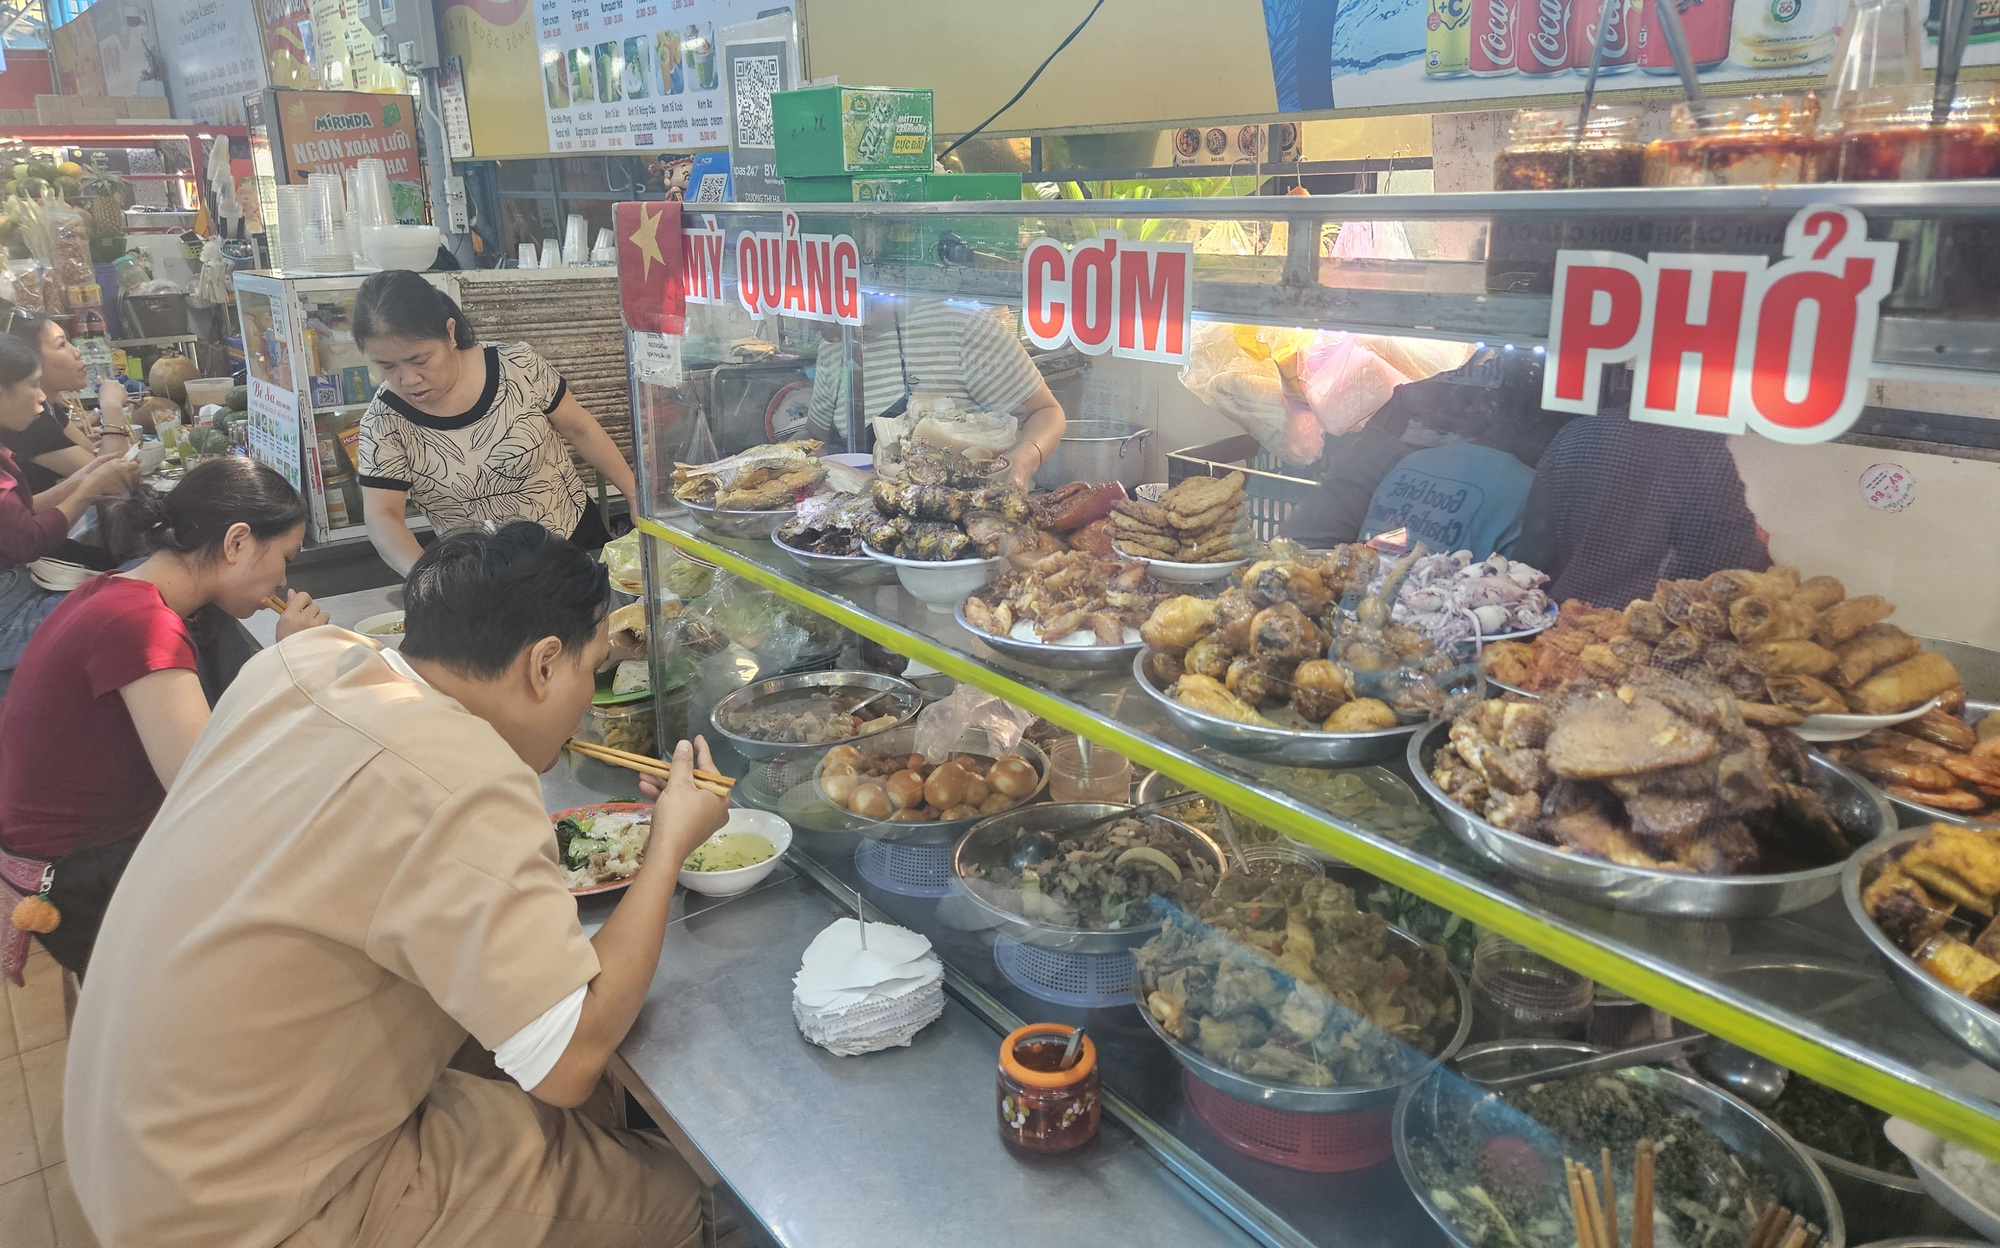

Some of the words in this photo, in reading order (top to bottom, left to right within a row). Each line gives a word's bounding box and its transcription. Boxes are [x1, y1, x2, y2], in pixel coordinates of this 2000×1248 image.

[292, 138, 344, 164] NGON
[344, 134, 380, 158] XOẮN
[858, 98, 891, 160] Sprite
[895, 139, 910, 152] CỰC
[911, 137, 925, 149] ĐÃ!
[746, 165, 758, 176] 247
[739, 212, 858, 320] QUẢNG
[1028, 238, 1186, 354] CƠM
[1554, 211, 1875, 428] PHỞ
